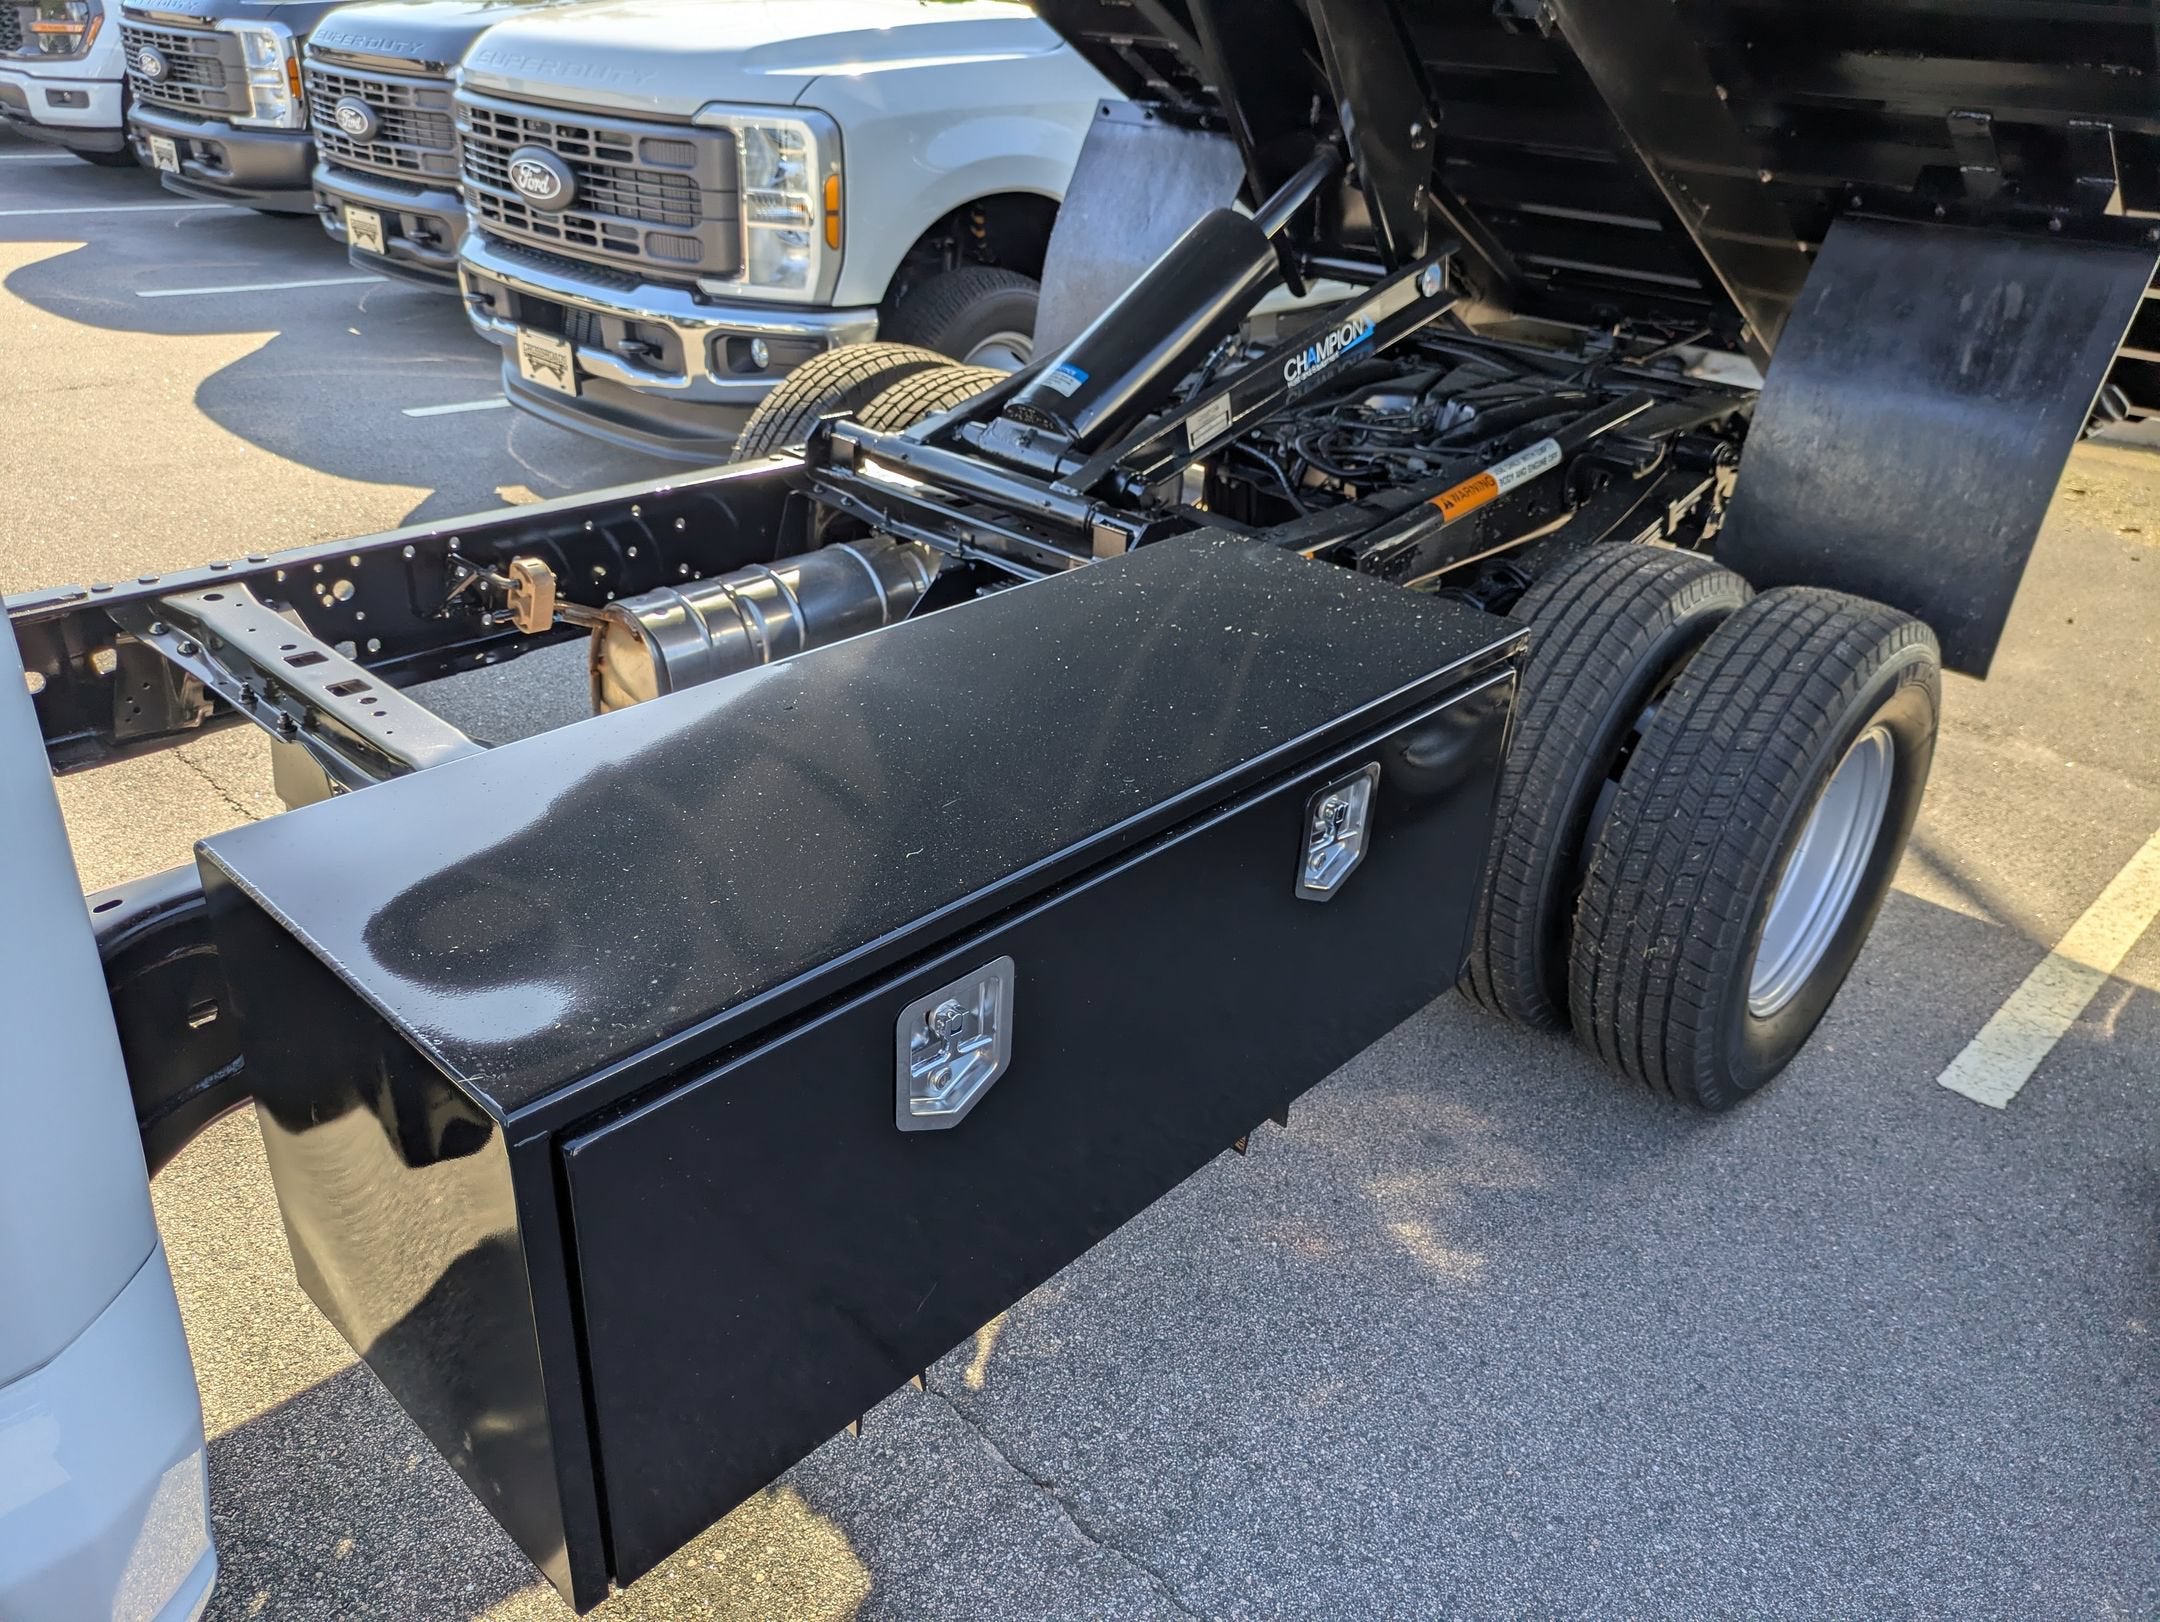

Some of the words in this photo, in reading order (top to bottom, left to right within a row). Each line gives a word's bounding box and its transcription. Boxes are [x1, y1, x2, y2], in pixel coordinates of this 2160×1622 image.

[316, 29, 366, 48] SUPER
[366, 38, 425, 55] DUTY
[476, 49, 561, 76] SUPER
[1283, 319, 1366, 382] CHAMPION
[1451, 476, 1496, 503] WARNING
